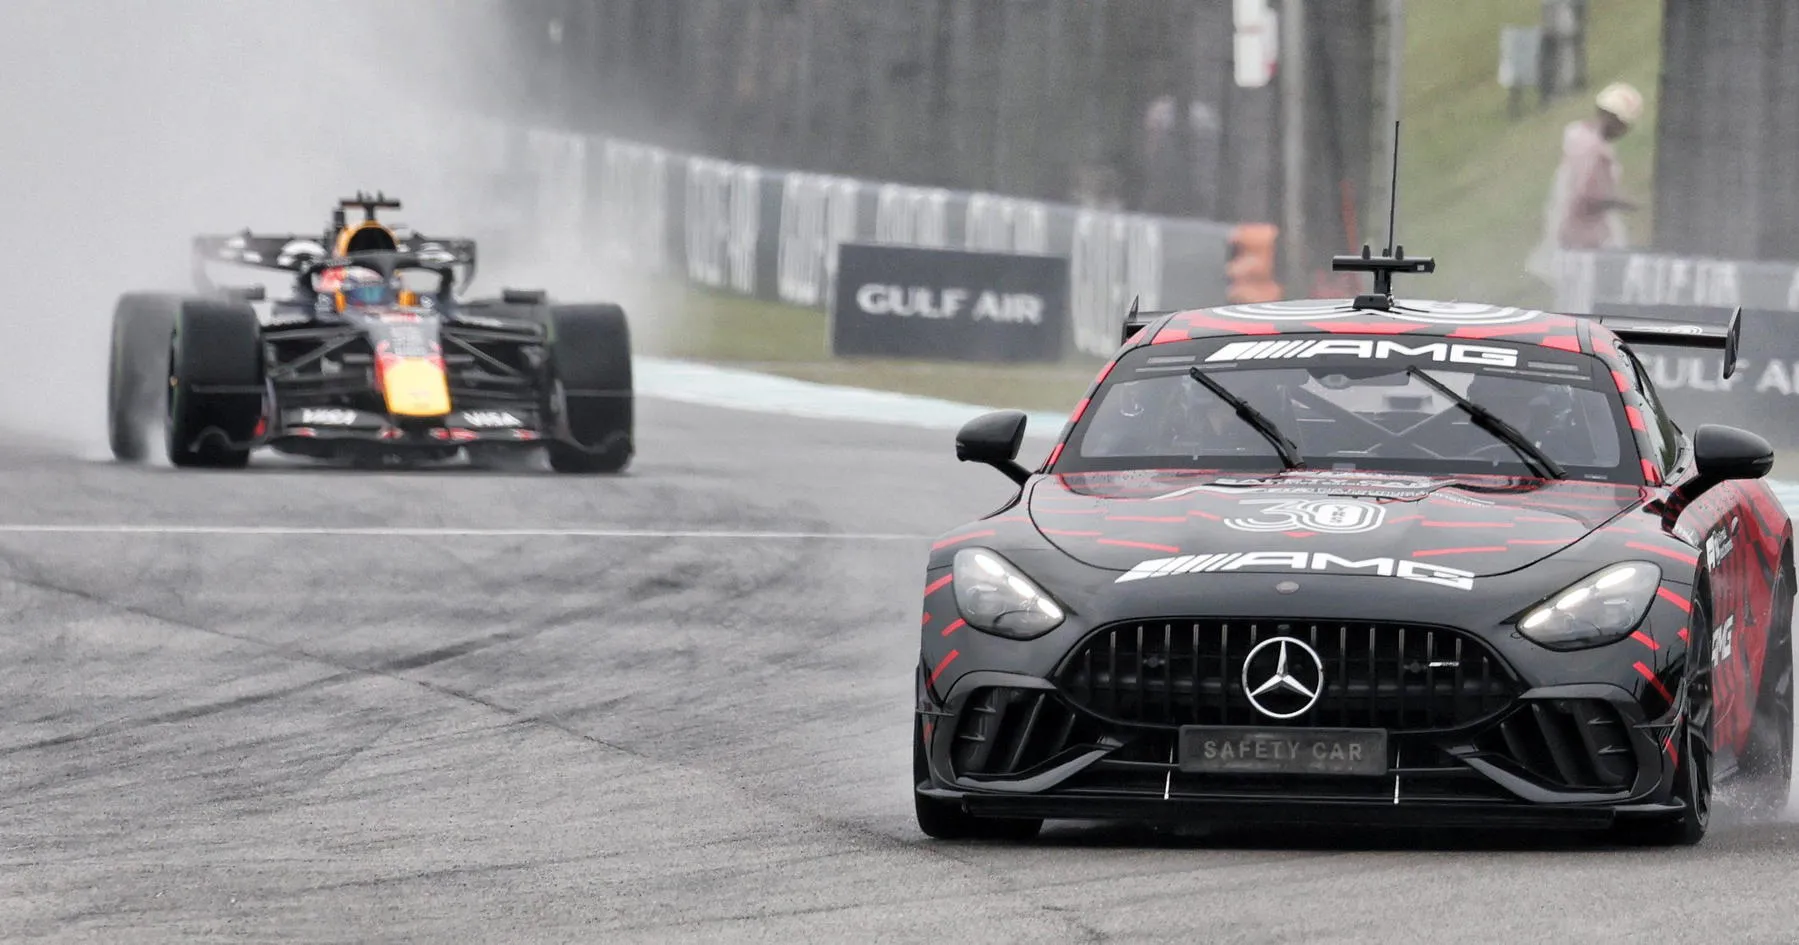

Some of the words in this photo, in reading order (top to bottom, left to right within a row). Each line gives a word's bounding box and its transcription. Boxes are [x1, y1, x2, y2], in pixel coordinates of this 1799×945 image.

[856, 283, 968, 319] GULF
[971, 289, 1045, 325] AIR
[1297, 339, 1518, 367] AMG
[1637, 352, 1749, 391] ULF
[1222, 551, 1475, 590] AMG
[1203, 740, 1300, 760] SAFETY
[1312, 741, 1362, 761] CAR
